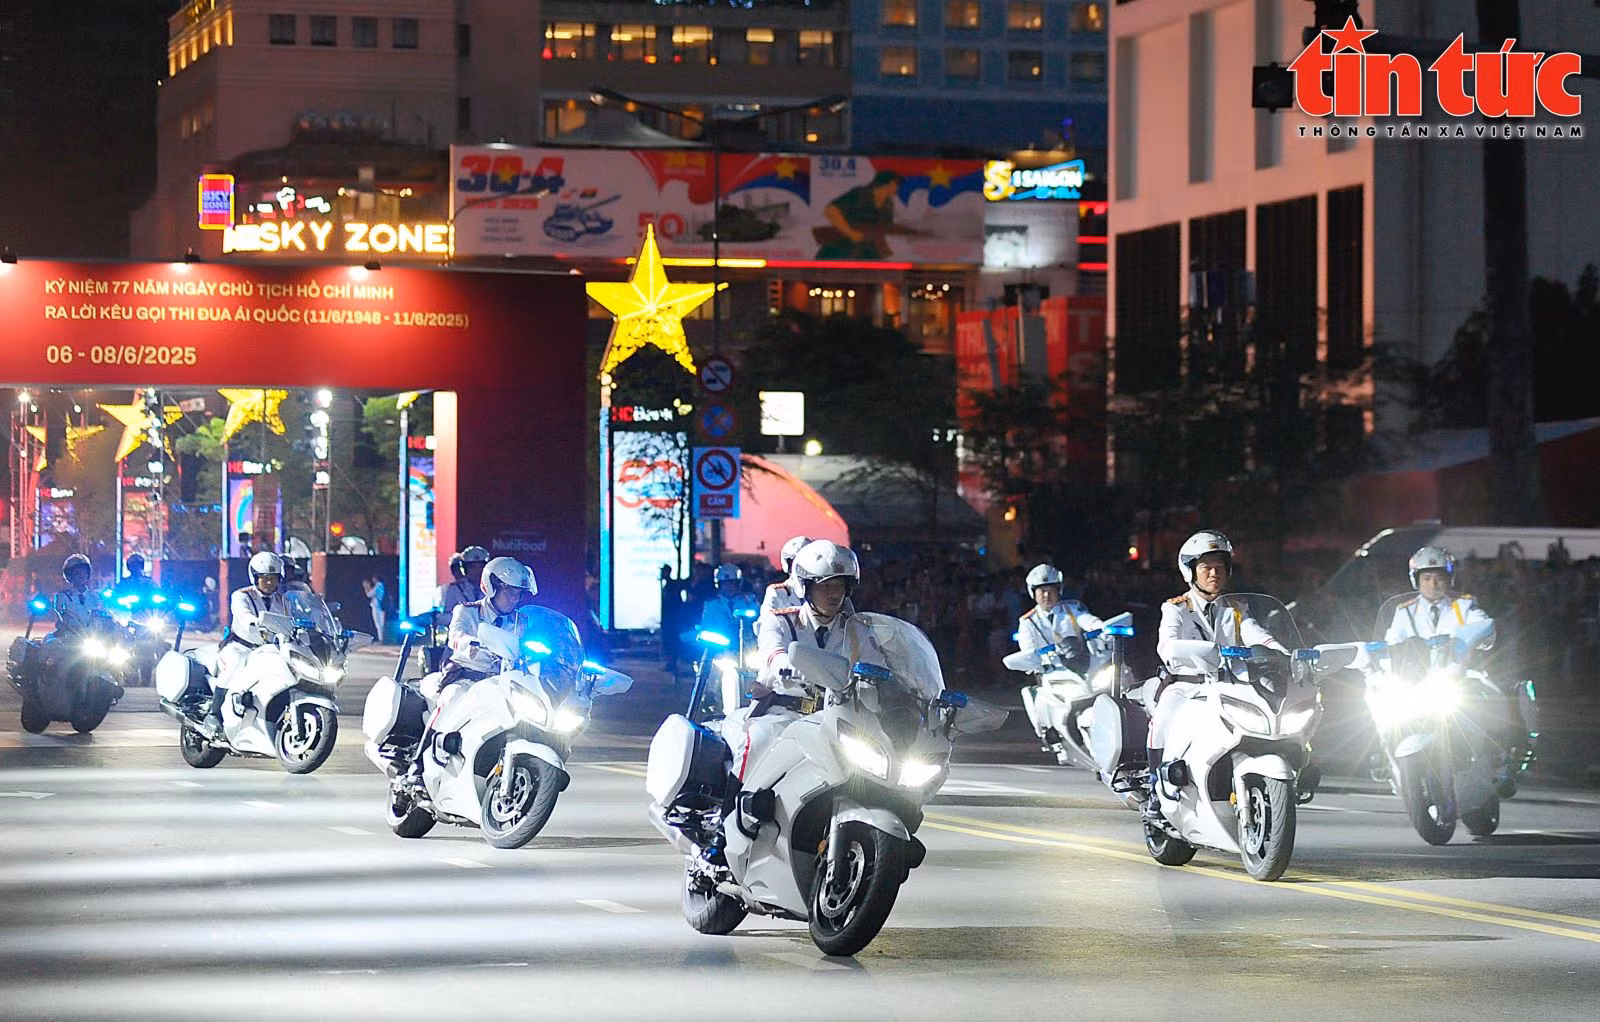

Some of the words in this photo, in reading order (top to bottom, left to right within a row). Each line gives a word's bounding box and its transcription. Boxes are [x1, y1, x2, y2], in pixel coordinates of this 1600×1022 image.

[260, 221, 332, 251] SKY
[344, 222, 449, 252] ZONE
[69, 278, 109, 297] NIỆM
[112, 281, 130, 294] 77
[133, 278, 169, 295] NĂM
[172, 279, 218, 296] NGÀY
[257, 284, 293, 299] TỊCH
[297, 280, 321, 298] HỒ
[323, 283, 350, 299] CHÍ
[353, 286, 395, 300] MINH
[45, 306, 68, 320] RA
[71, 304, 96, 320] LỜI
[100, 304, 133, 320] KÊU
[136, 307, 165, 323] GỌI
[168, 307, 194, 320] THI
[197, 308, 233, 321] ĐUA
[234, 305, 250, 321] ÁI
[253, 304, 300, 324] QUỐC
[303, 309, 382, 325] (11/6/1948
[393, 311, 470, 328] 11/6/2025)
[46, 345, 73, 363] 06
[91, 345, 197, 365] 08/6/2025
